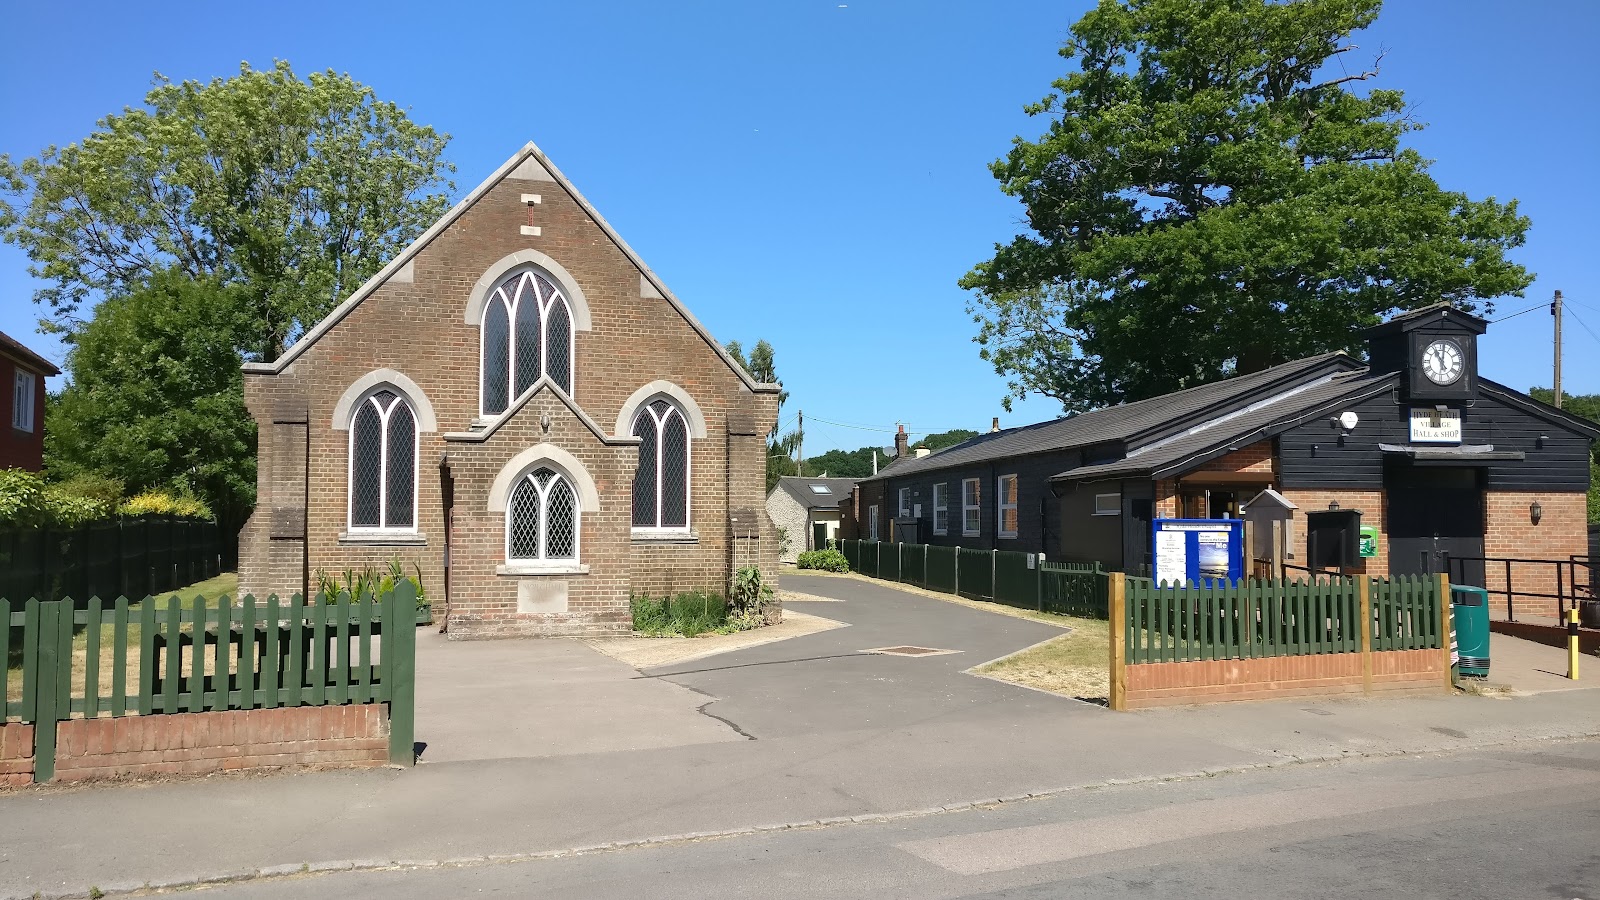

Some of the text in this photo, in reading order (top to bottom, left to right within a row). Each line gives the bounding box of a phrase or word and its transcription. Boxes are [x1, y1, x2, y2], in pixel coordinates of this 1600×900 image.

[1434, 411, 1457, 420] HEATH
[1413, 429, 1432, 438] HALL
[1440, 430, 1459, 438] SHOP
